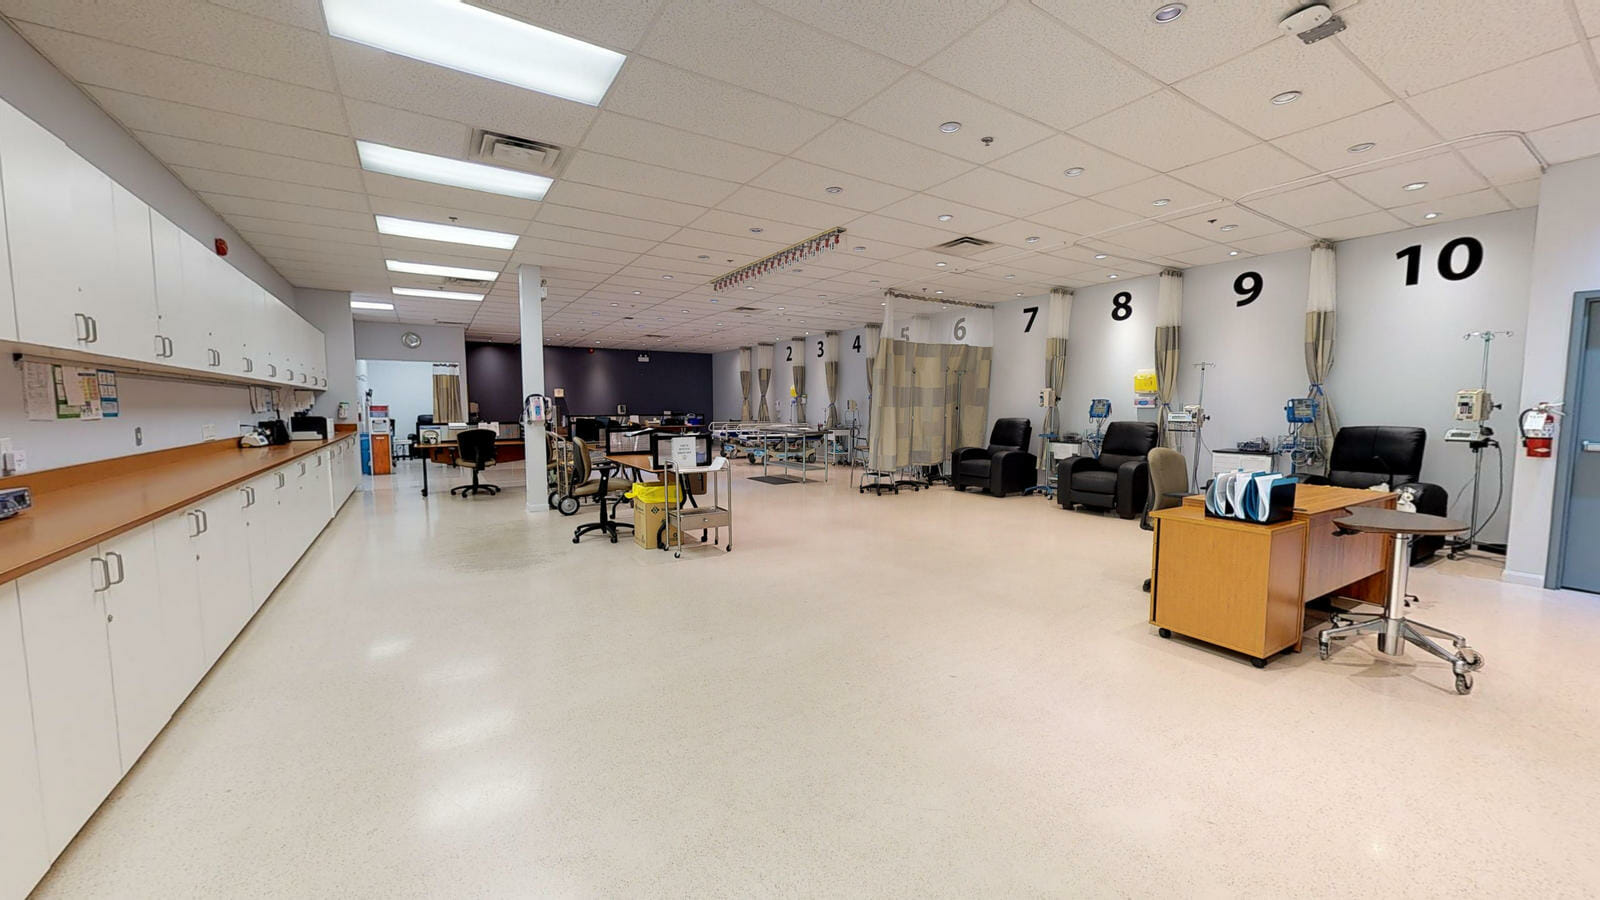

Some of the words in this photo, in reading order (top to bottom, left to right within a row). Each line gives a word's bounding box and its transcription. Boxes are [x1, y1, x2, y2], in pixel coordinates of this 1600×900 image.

[1395, 236, 1484, 286] 10
[1233, 271, 1264, 308] 9
[1111, 291, 1133, 321] 8
[953, 317, 967, 341] 6
[1023, 306, 1039, 333] 7
[852, 335, 862, 353] 4
[900, 326, 910, 342] 5
[785, 346, 793, 362] 2
[817, 340, 825, 358] 3
